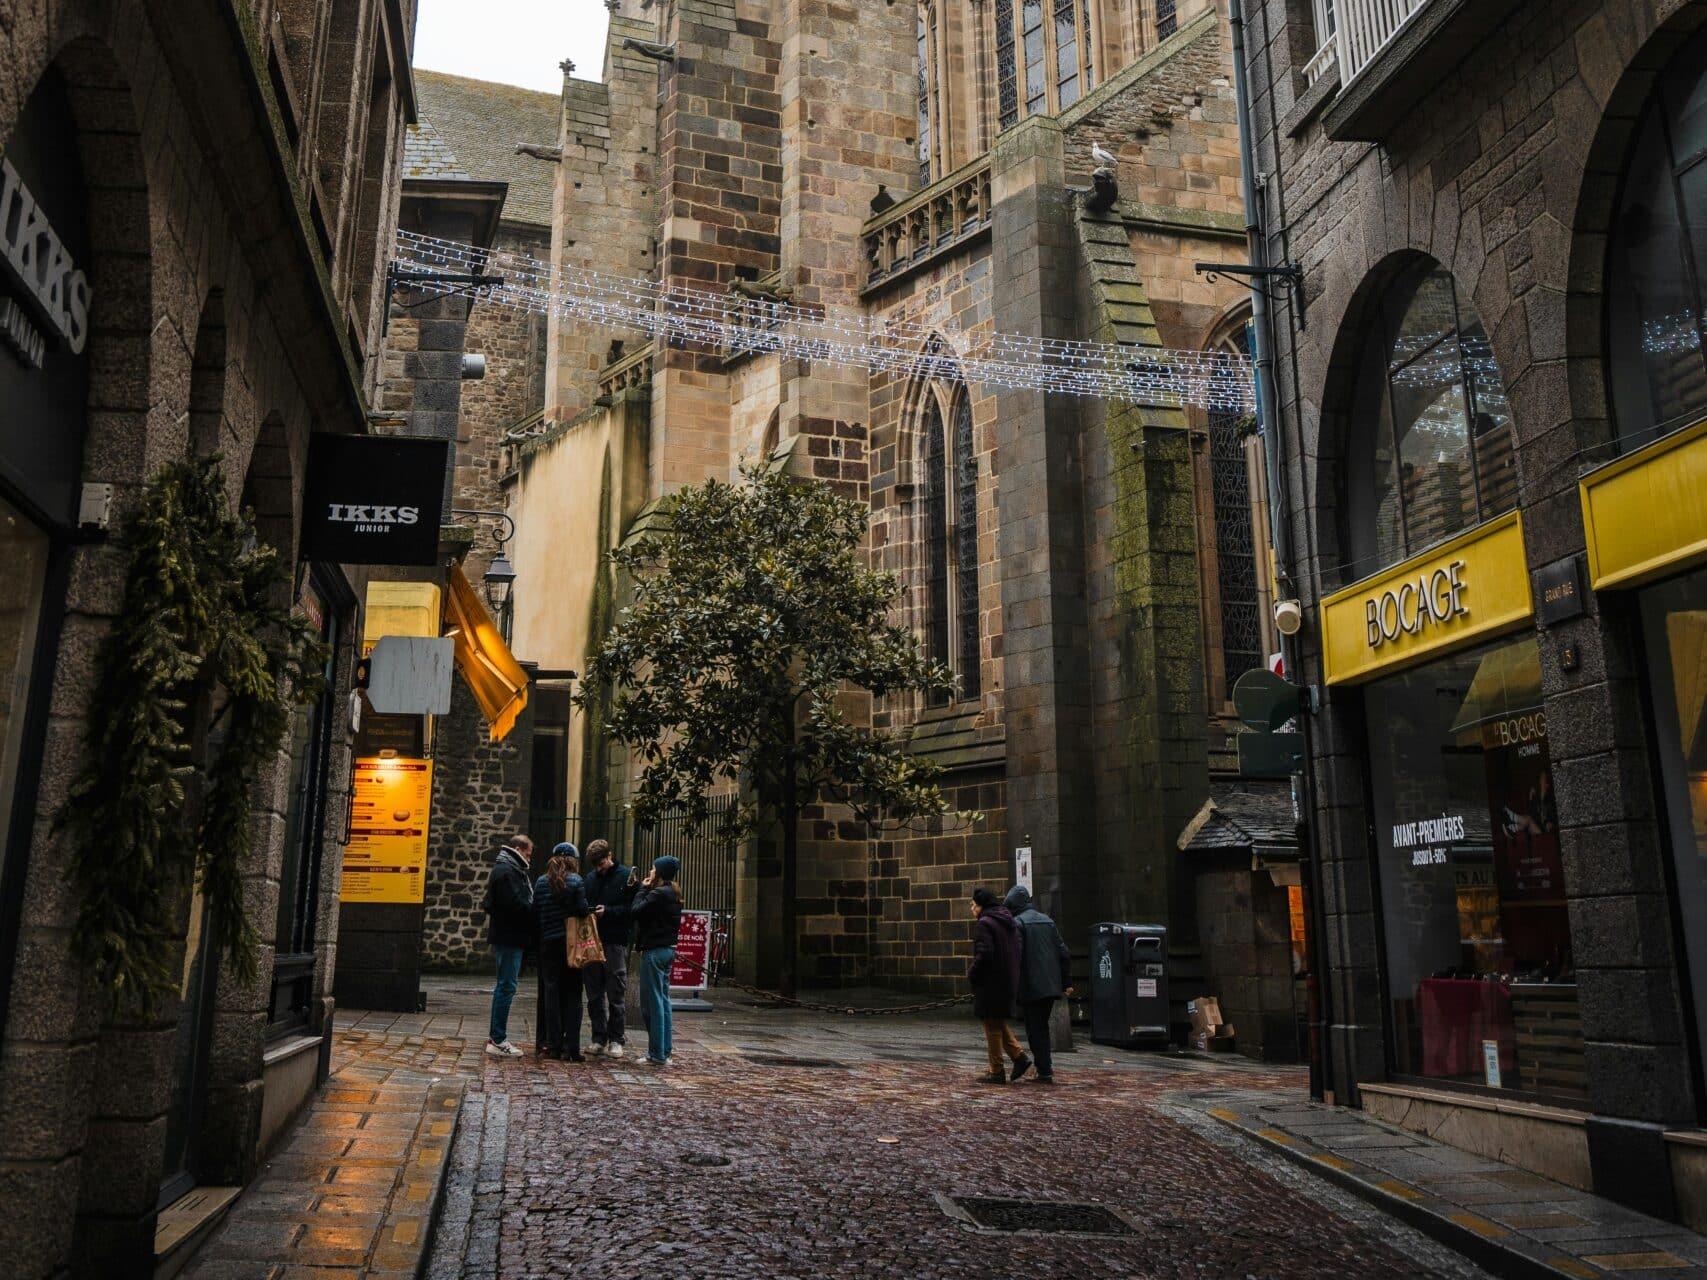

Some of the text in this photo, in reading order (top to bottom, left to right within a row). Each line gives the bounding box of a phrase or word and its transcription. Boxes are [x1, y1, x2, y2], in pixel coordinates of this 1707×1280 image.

[328, 503, 419, 525] IKKS
[354, 524, 391, 533] JUNIOR
[1366, 559, 1470, 648] BOCAGE
[1392, 812, 1465, 848] AVANT-PREMIÈRES
